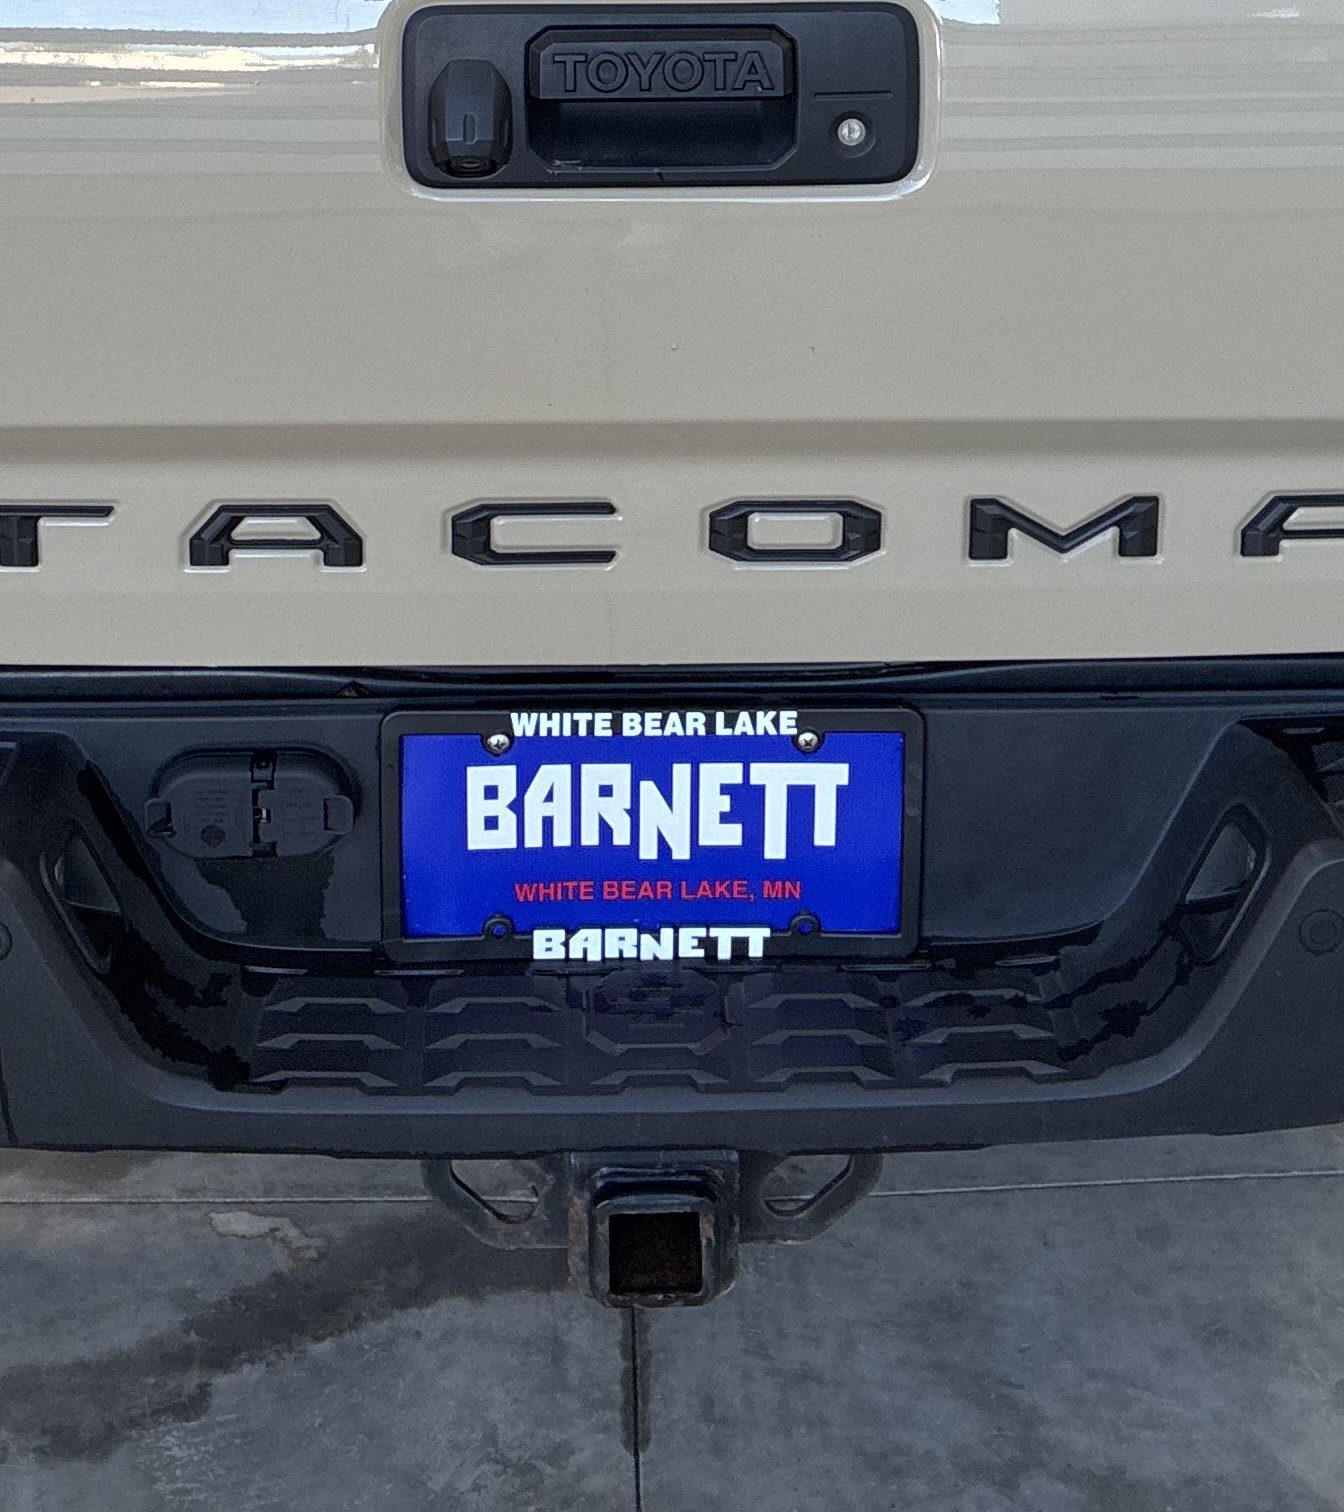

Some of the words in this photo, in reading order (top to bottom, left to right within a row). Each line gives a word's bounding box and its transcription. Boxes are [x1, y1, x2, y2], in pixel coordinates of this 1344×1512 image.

[553, 50, 774, 93] TOYOTA
[510, 711, 613, 737] WHITE
[622, 711, 706, 737] BEAR
[715, 710, 798, 736] LAKE
[466, 763, 850, 860] BARNETT
[514, 881, 595, 903] WHITE
[602, 880, 673, 901] BEAR
[680, 880, 755, 902] LAKE,
[762, 880, 802, 900] MN
[532, 927, 771, 962] BARNETT
